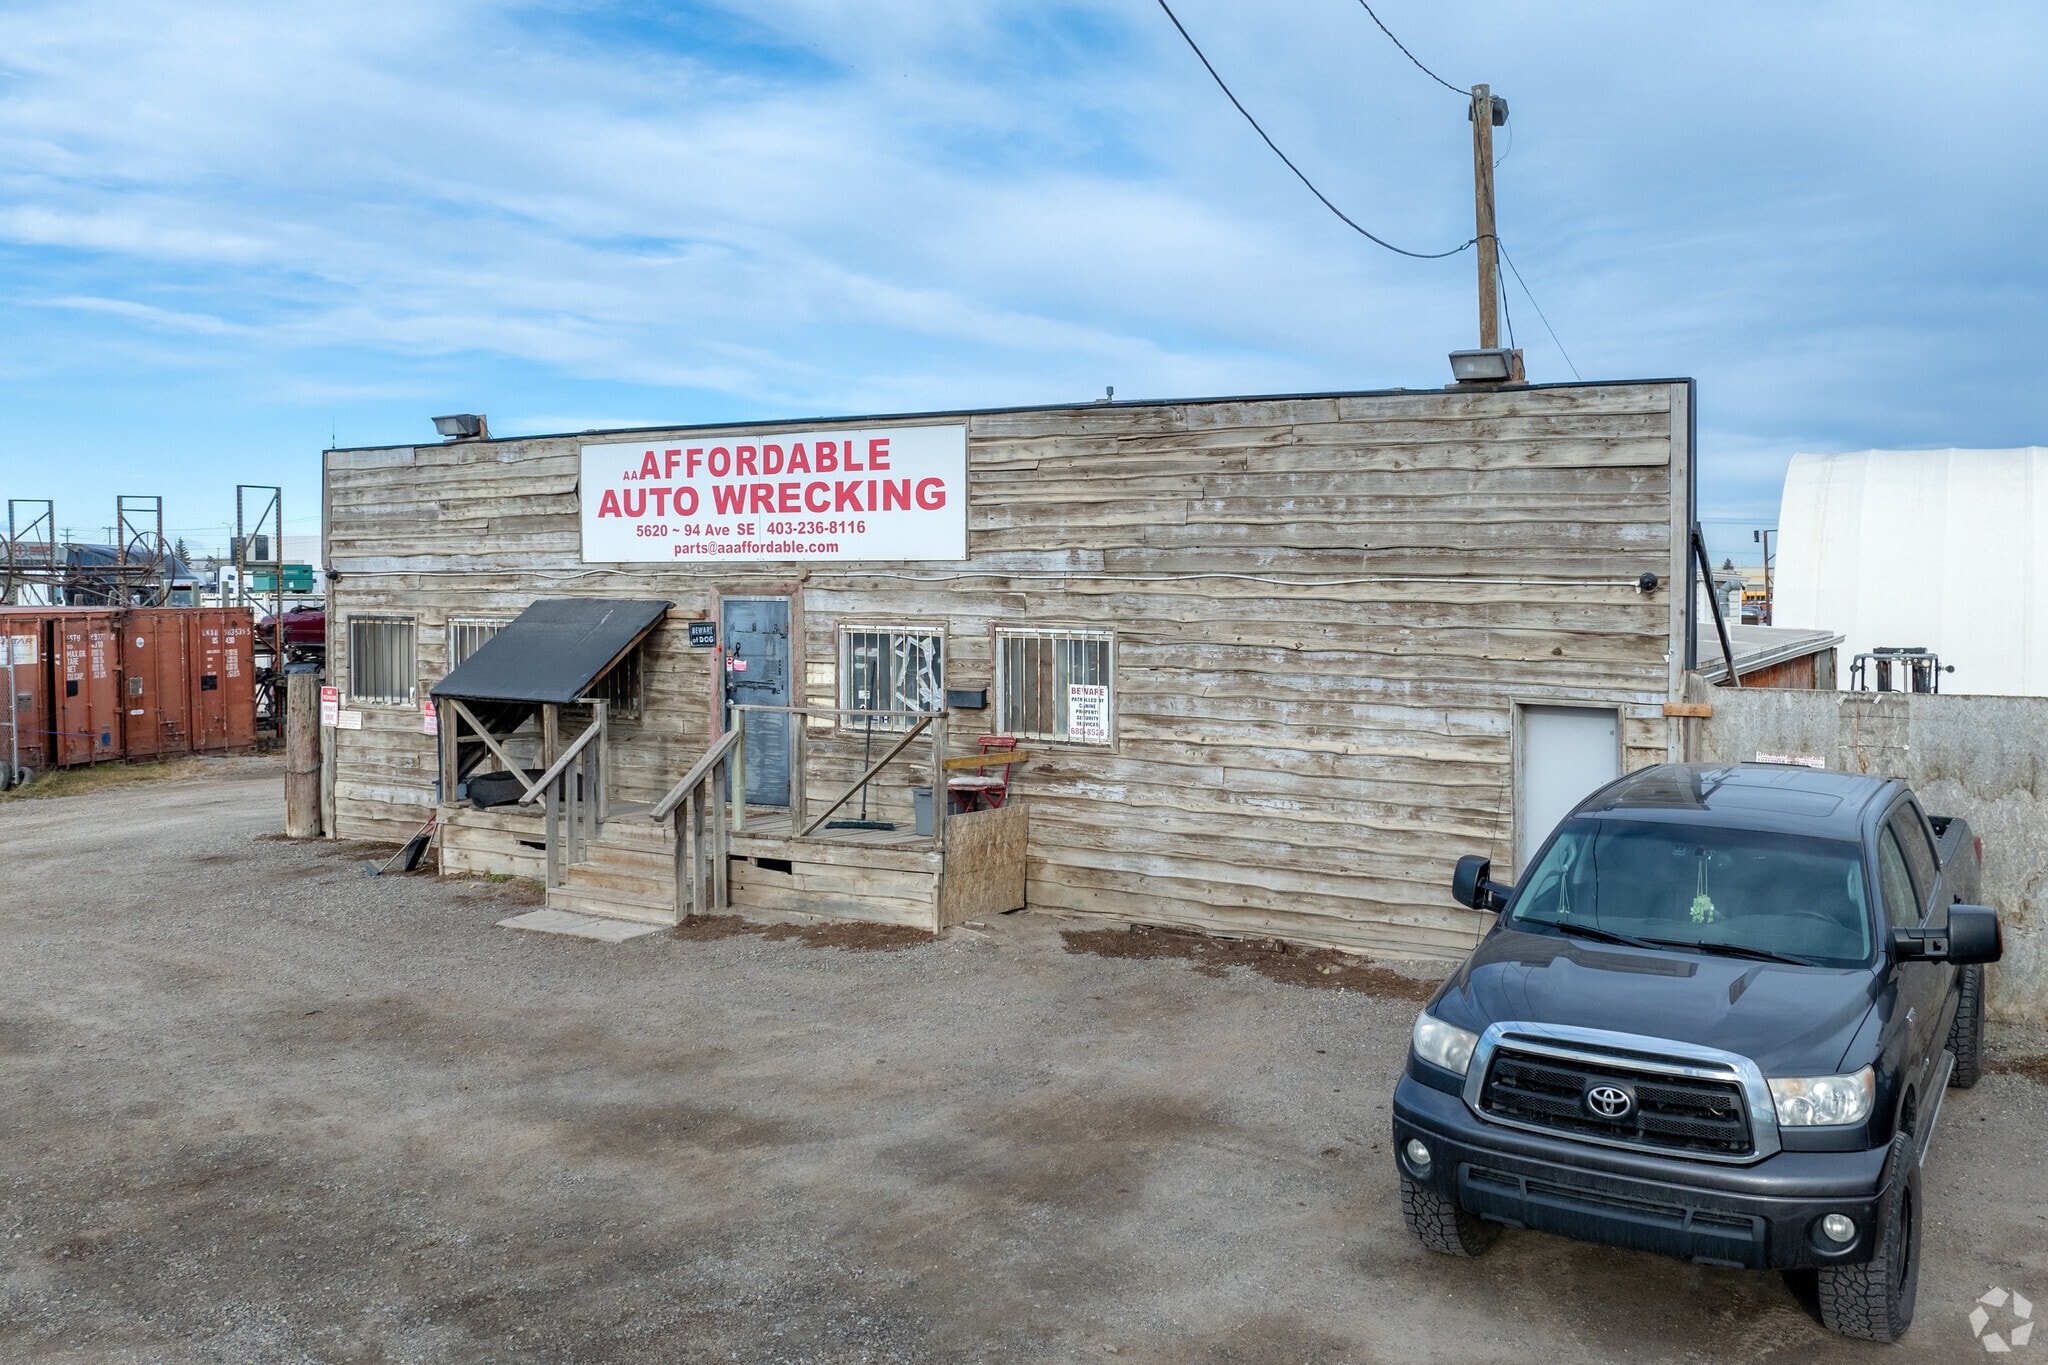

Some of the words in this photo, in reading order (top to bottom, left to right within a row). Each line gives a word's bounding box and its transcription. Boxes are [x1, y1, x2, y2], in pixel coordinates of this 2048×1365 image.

[598, 486, 699, 518] AUTO
[712, 476, 946, 515] WRECKING
[636, 524, 668, 538] 5620
[684, 524, 702, 537] 94
[704, 523, 730, 536] Ave
[737, 522, 756, 536] SE
[766, 520, 866, 535] 403-236-8116
[674, 540, 839, 556] parts@aaaffordable.com
[692, 626, 713, 634] BEWARE
[1071, 687, 1104, 696] BEWARE
